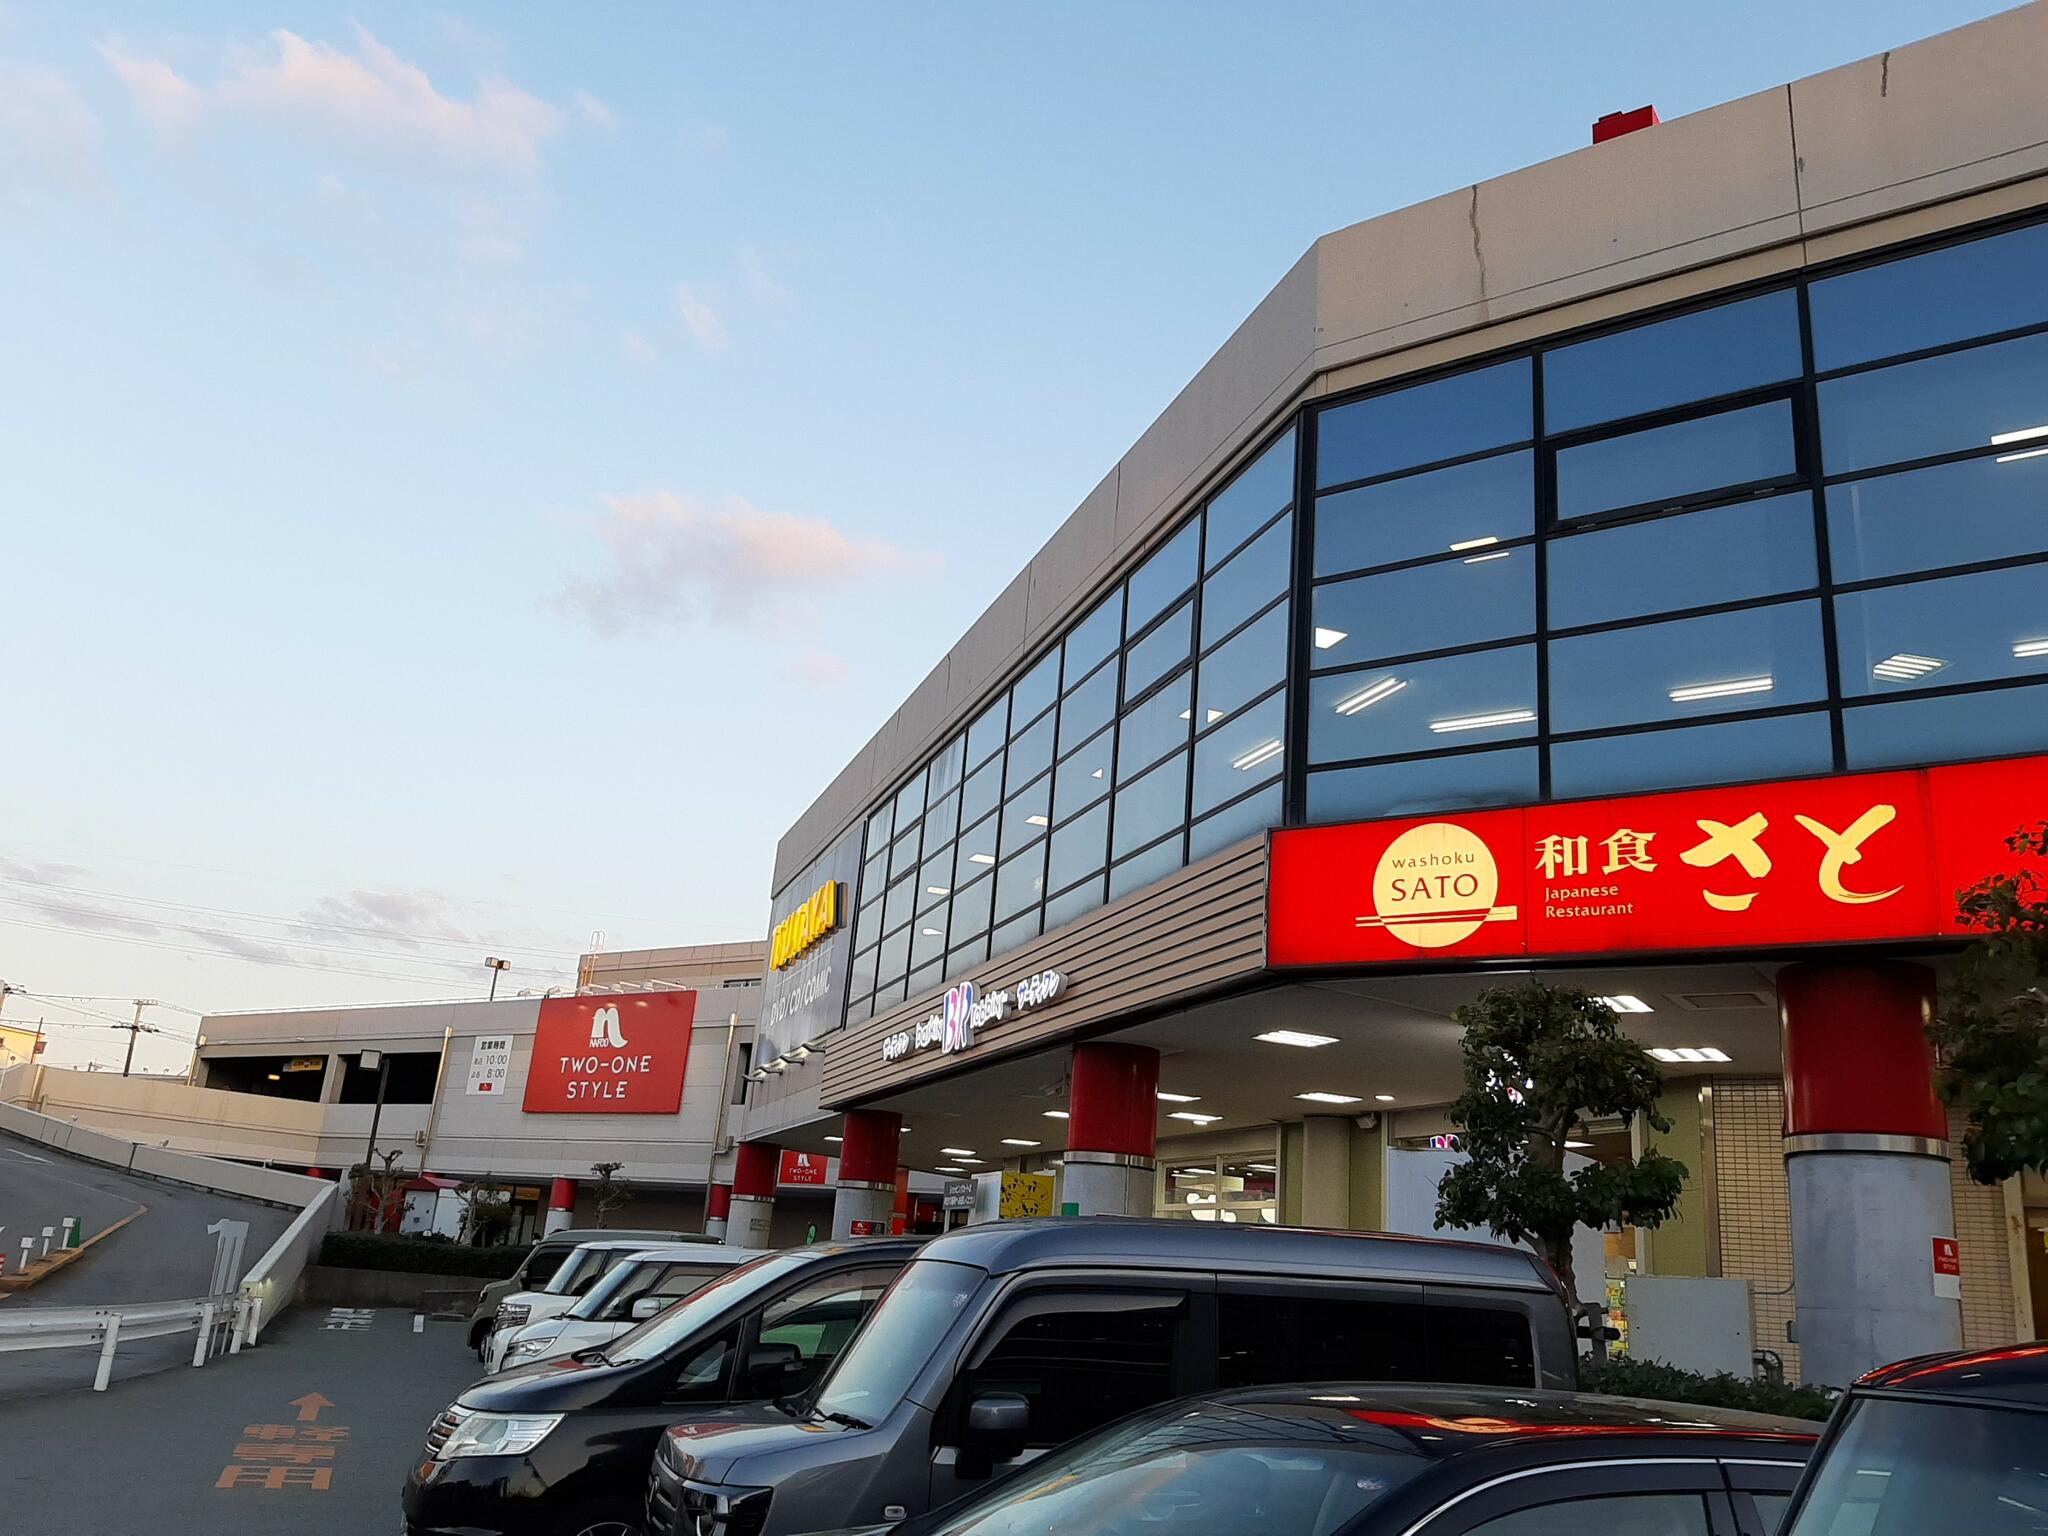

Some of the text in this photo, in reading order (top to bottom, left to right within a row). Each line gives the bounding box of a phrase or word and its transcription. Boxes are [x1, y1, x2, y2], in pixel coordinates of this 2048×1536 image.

[1391, 851, 1475, 868] washoku
[1533, 803, 1905, 912] 和食 さと
[1391, 873, 1479, 902] SATO
[1544, 884, 1620, 902] Japanese
[1544, 901, 1634, 919] Restaurant
[486, 1055, 507, 1065] 10:00
[560, 1054, 652, 1074] TWO-ONE
[486, 1068, 505, 1079] 8:00
[566, 1080, 629, 1099] STYLE
